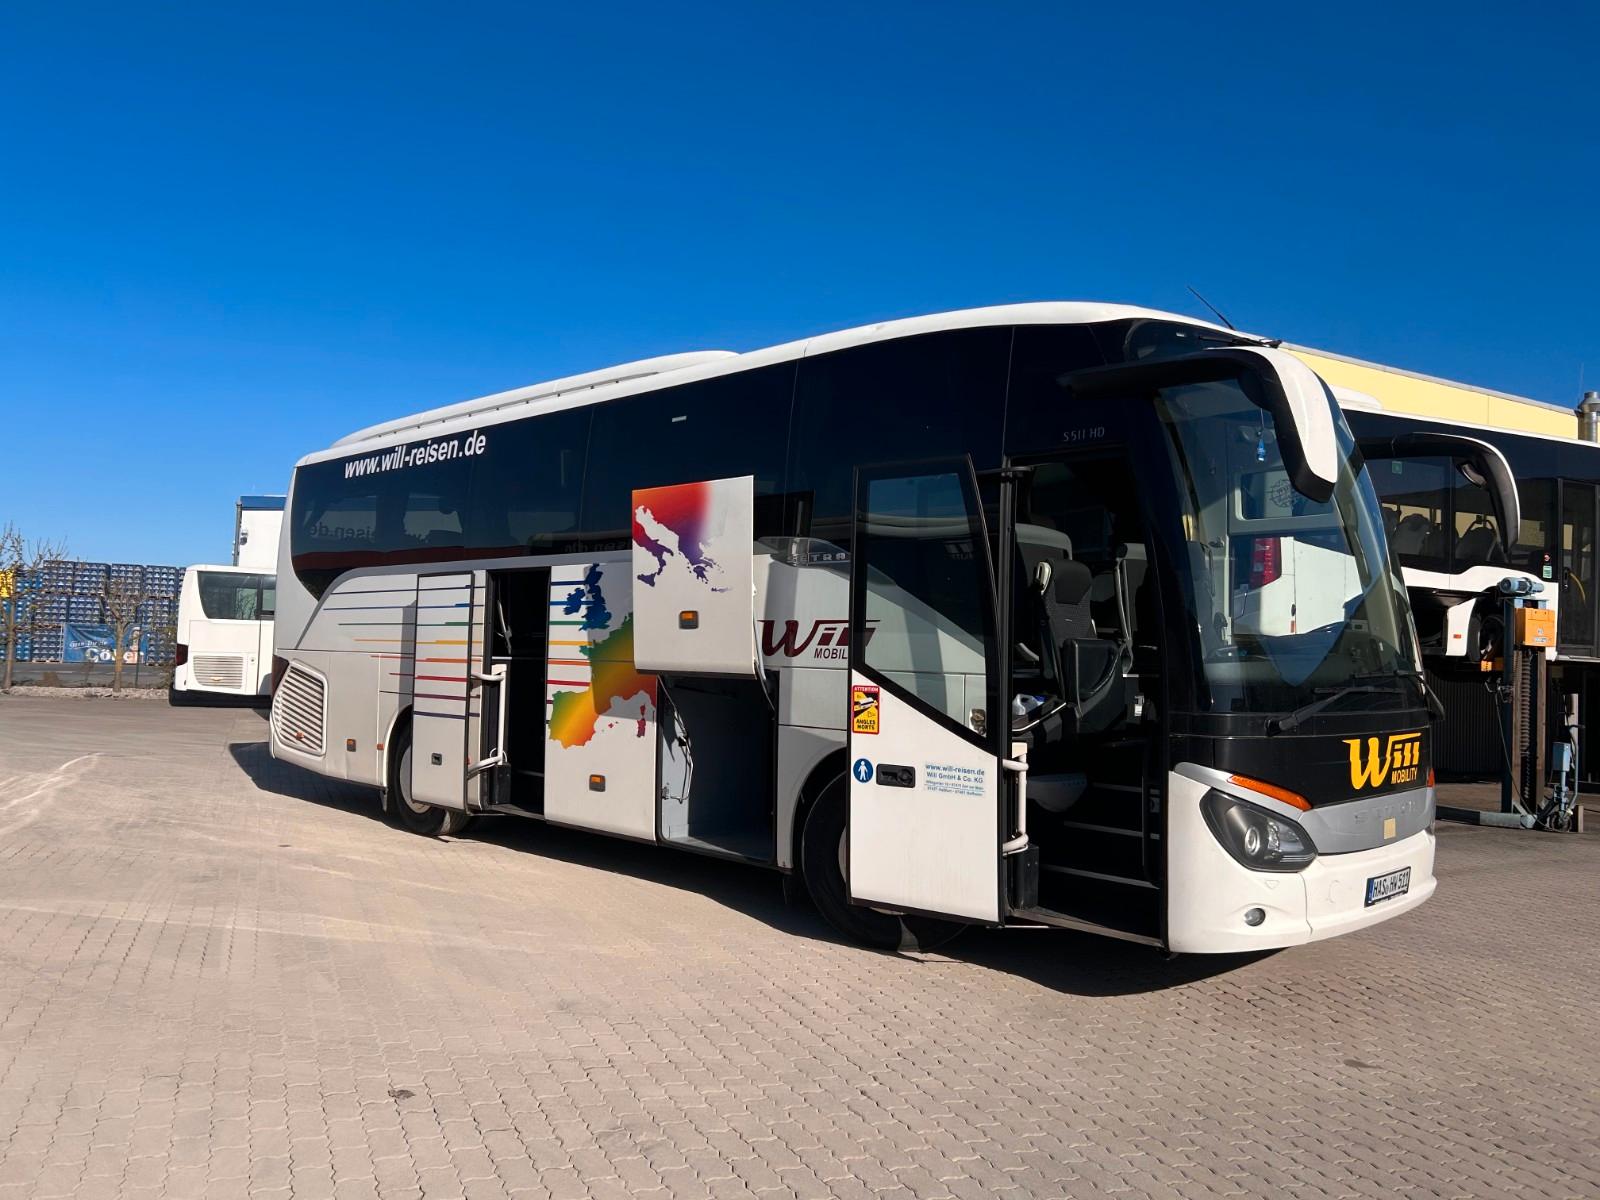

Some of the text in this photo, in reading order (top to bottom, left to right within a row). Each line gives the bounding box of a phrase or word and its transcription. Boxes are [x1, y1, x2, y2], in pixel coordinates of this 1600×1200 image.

[345, 430, 486, 479] www.will-reisen.de
[814, 648, 848, 659] MOBIL
[926, 764, 985, 776] www.will-reisen.de
[1342, 732, 1421, 790] Will
[1390, 767, 1418, 785] MOBILITY
[1373, 878, 1387, 898] HAS
